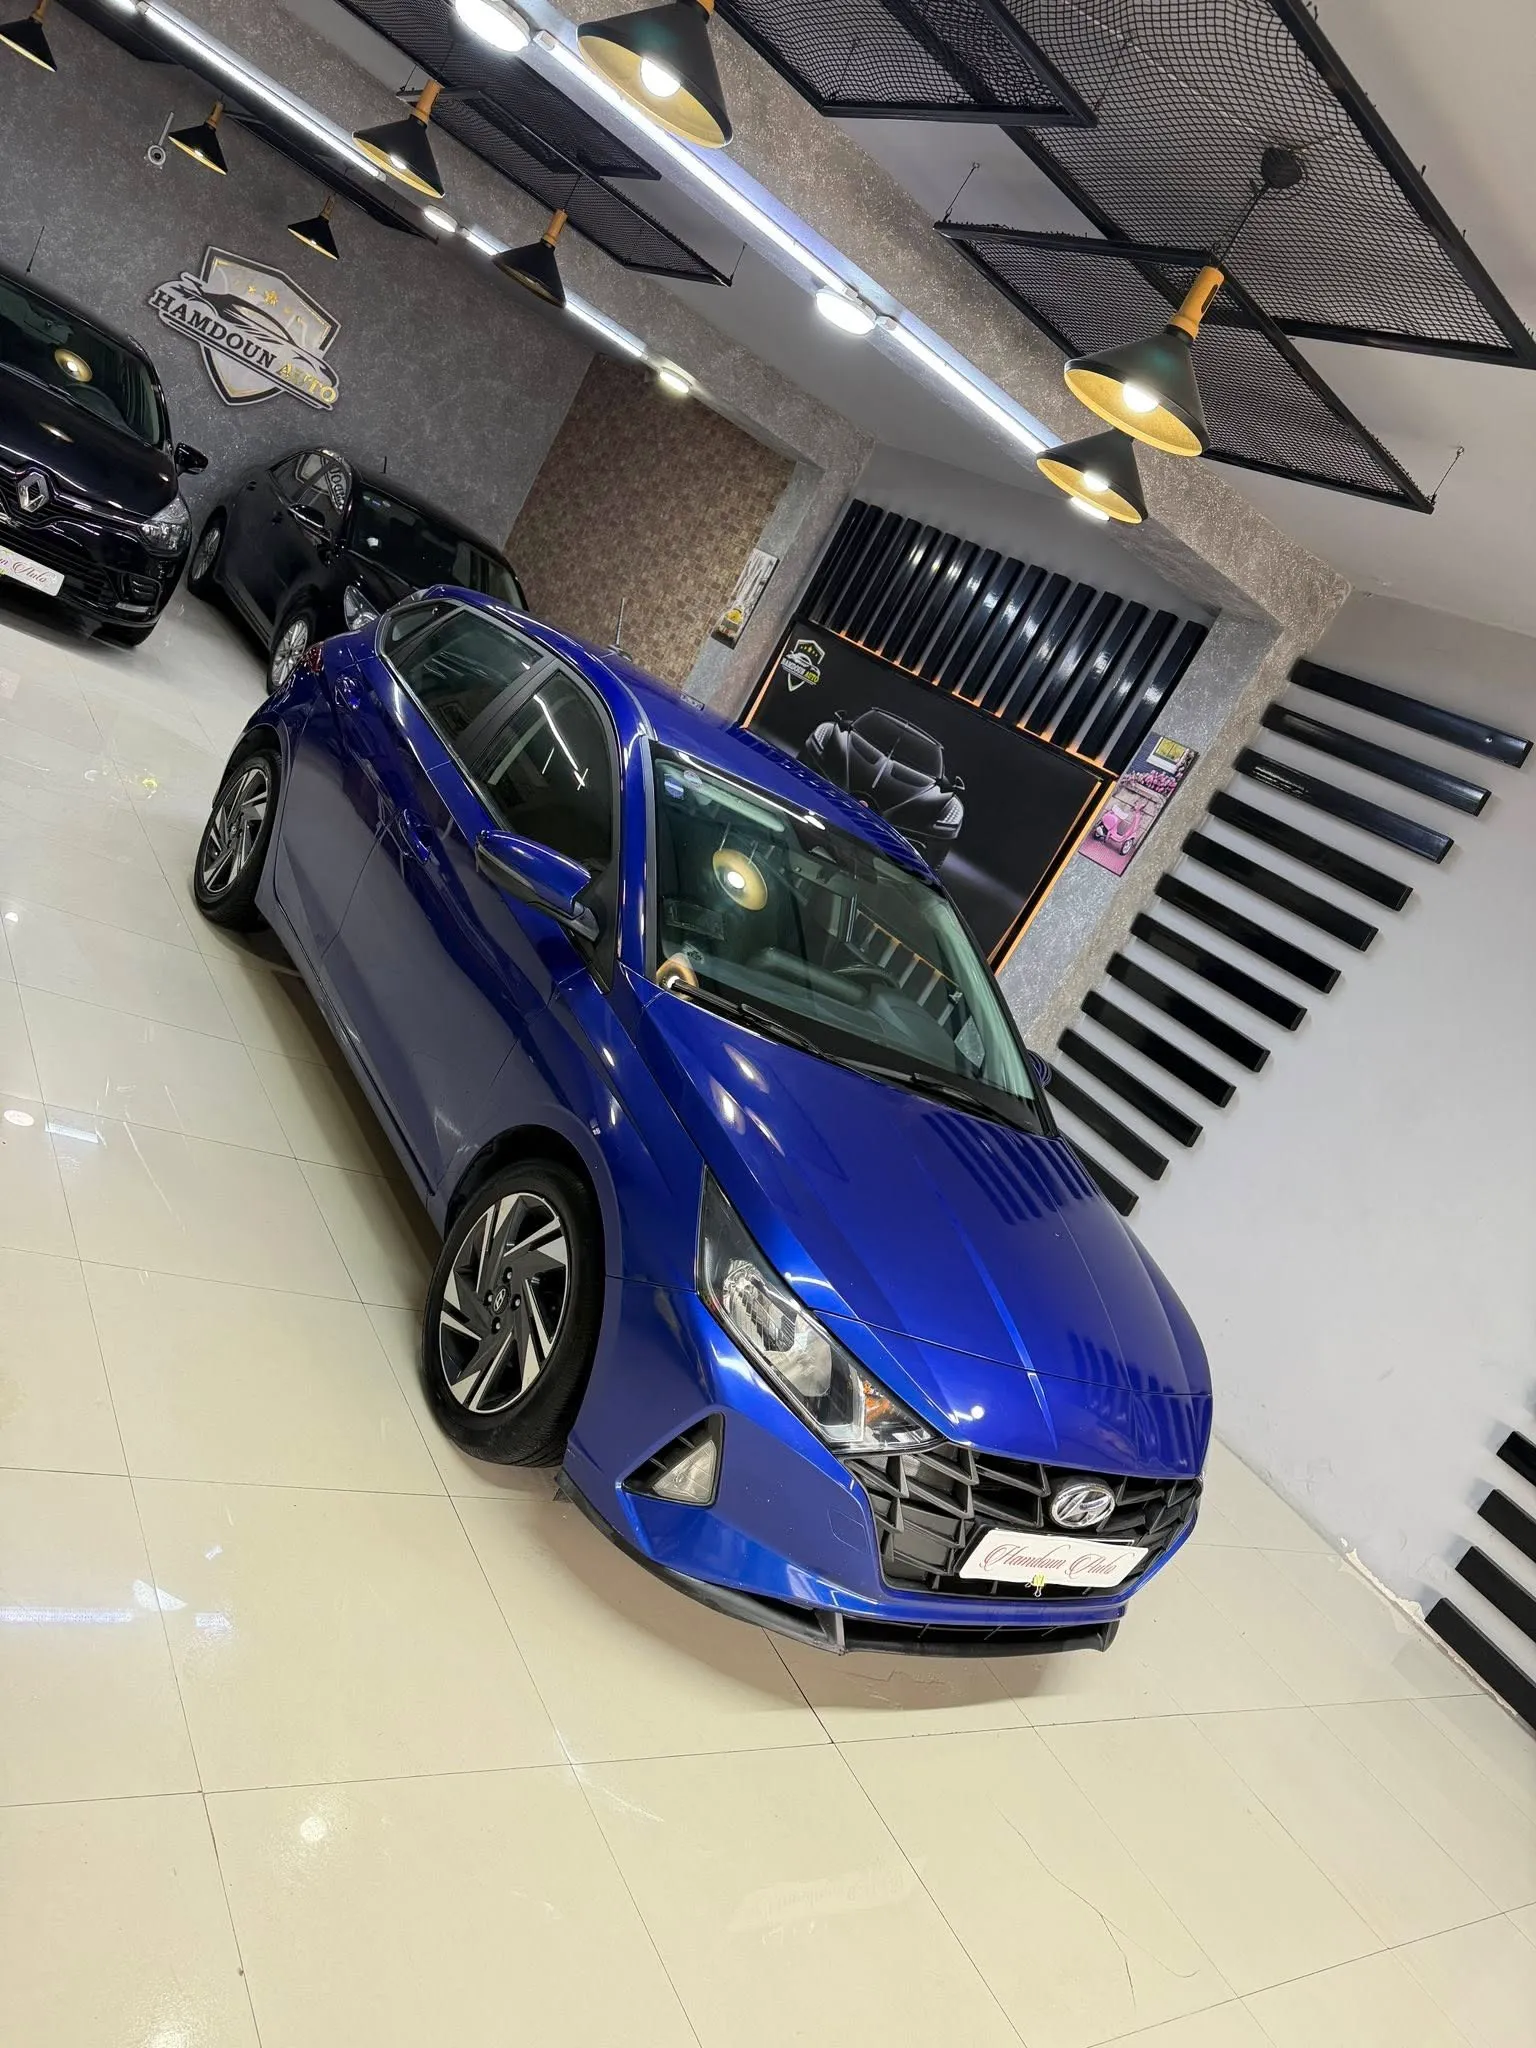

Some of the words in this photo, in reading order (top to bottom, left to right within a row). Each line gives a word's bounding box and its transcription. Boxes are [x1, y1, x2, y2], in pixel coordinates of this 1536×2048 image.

[151, 290, 277, 369] HAMDOUN
[276, 363, 337, 403] AUTO
[979, 1544, 1070, 1571] Hamdoun
[1065, 1552, 1135, 1579] Auto
